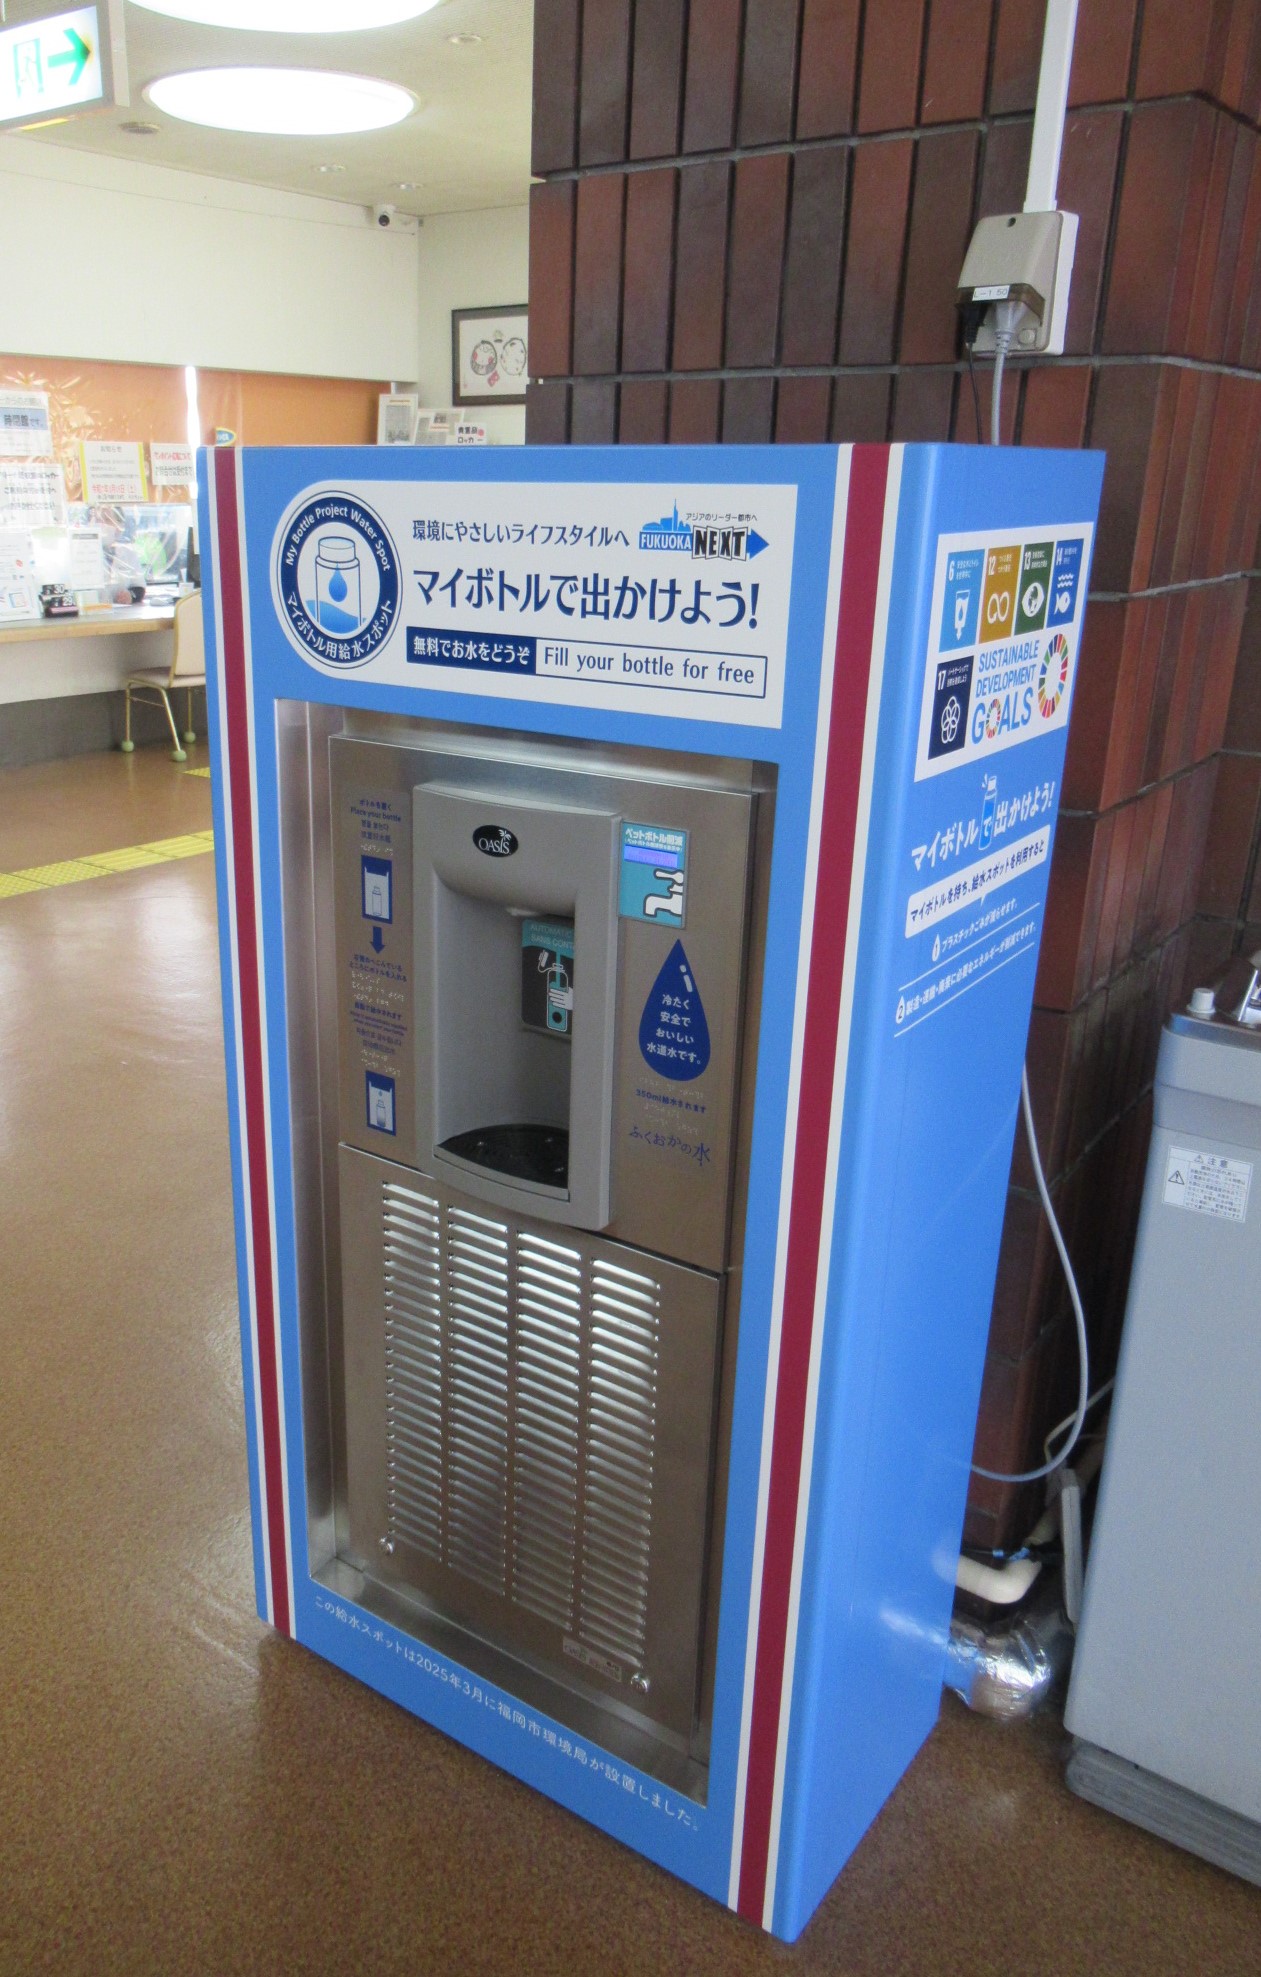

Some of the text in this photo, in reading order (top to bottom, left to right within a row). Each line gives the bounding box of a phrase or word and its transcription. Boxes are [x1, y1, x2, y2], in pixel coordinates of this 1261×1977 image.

[685, 512, 758, 522] アジアのリーダー都市へ
[285, 504, 391, 571] My Bottle Project Water Spot
[412, 519, 630, 547] 環境にやさしいライフスタイルへ
[641, 529, 745, 557] FUKUOKA NEXT
[949, 560, 955, 582] 6
[988, 555, 997, 576] 12
[288, 591, 394, 660] マイボトル用給水スポット
[413, 636, 531, 665] 無料でお水をどうぞ
[978, 639, 1040, 673] SUSTAINABLE
[544, 646, 755, 684] Fill your bottle for free
[938, 669, 946, 691] 17
[975, 664, 1037, 698] DEVELOPMENT
[971, 687, 1034, 745] GOALS
[382, 811, 402, 823] bottle
[478, 837, 510, 854] OASIS
[910, 839, 1045, 922] マイボトルを持ち、給水スポットを利用すると
[661, 993, 690, 1010] 冷たく
[660, 1011, 692, 1027] 安全で
[655, 1027, 695, 1044] おいしい
[646, 1042, 701, 1065] 水道水です。
[635, 1088, 706, 1114] 350ml給水されます
[628, 1126, 711, 1167] ふくおかの水
[314, 1596, 698, 1831] この給水スポットは2025年3月に福岡市環境局が設置しました。
